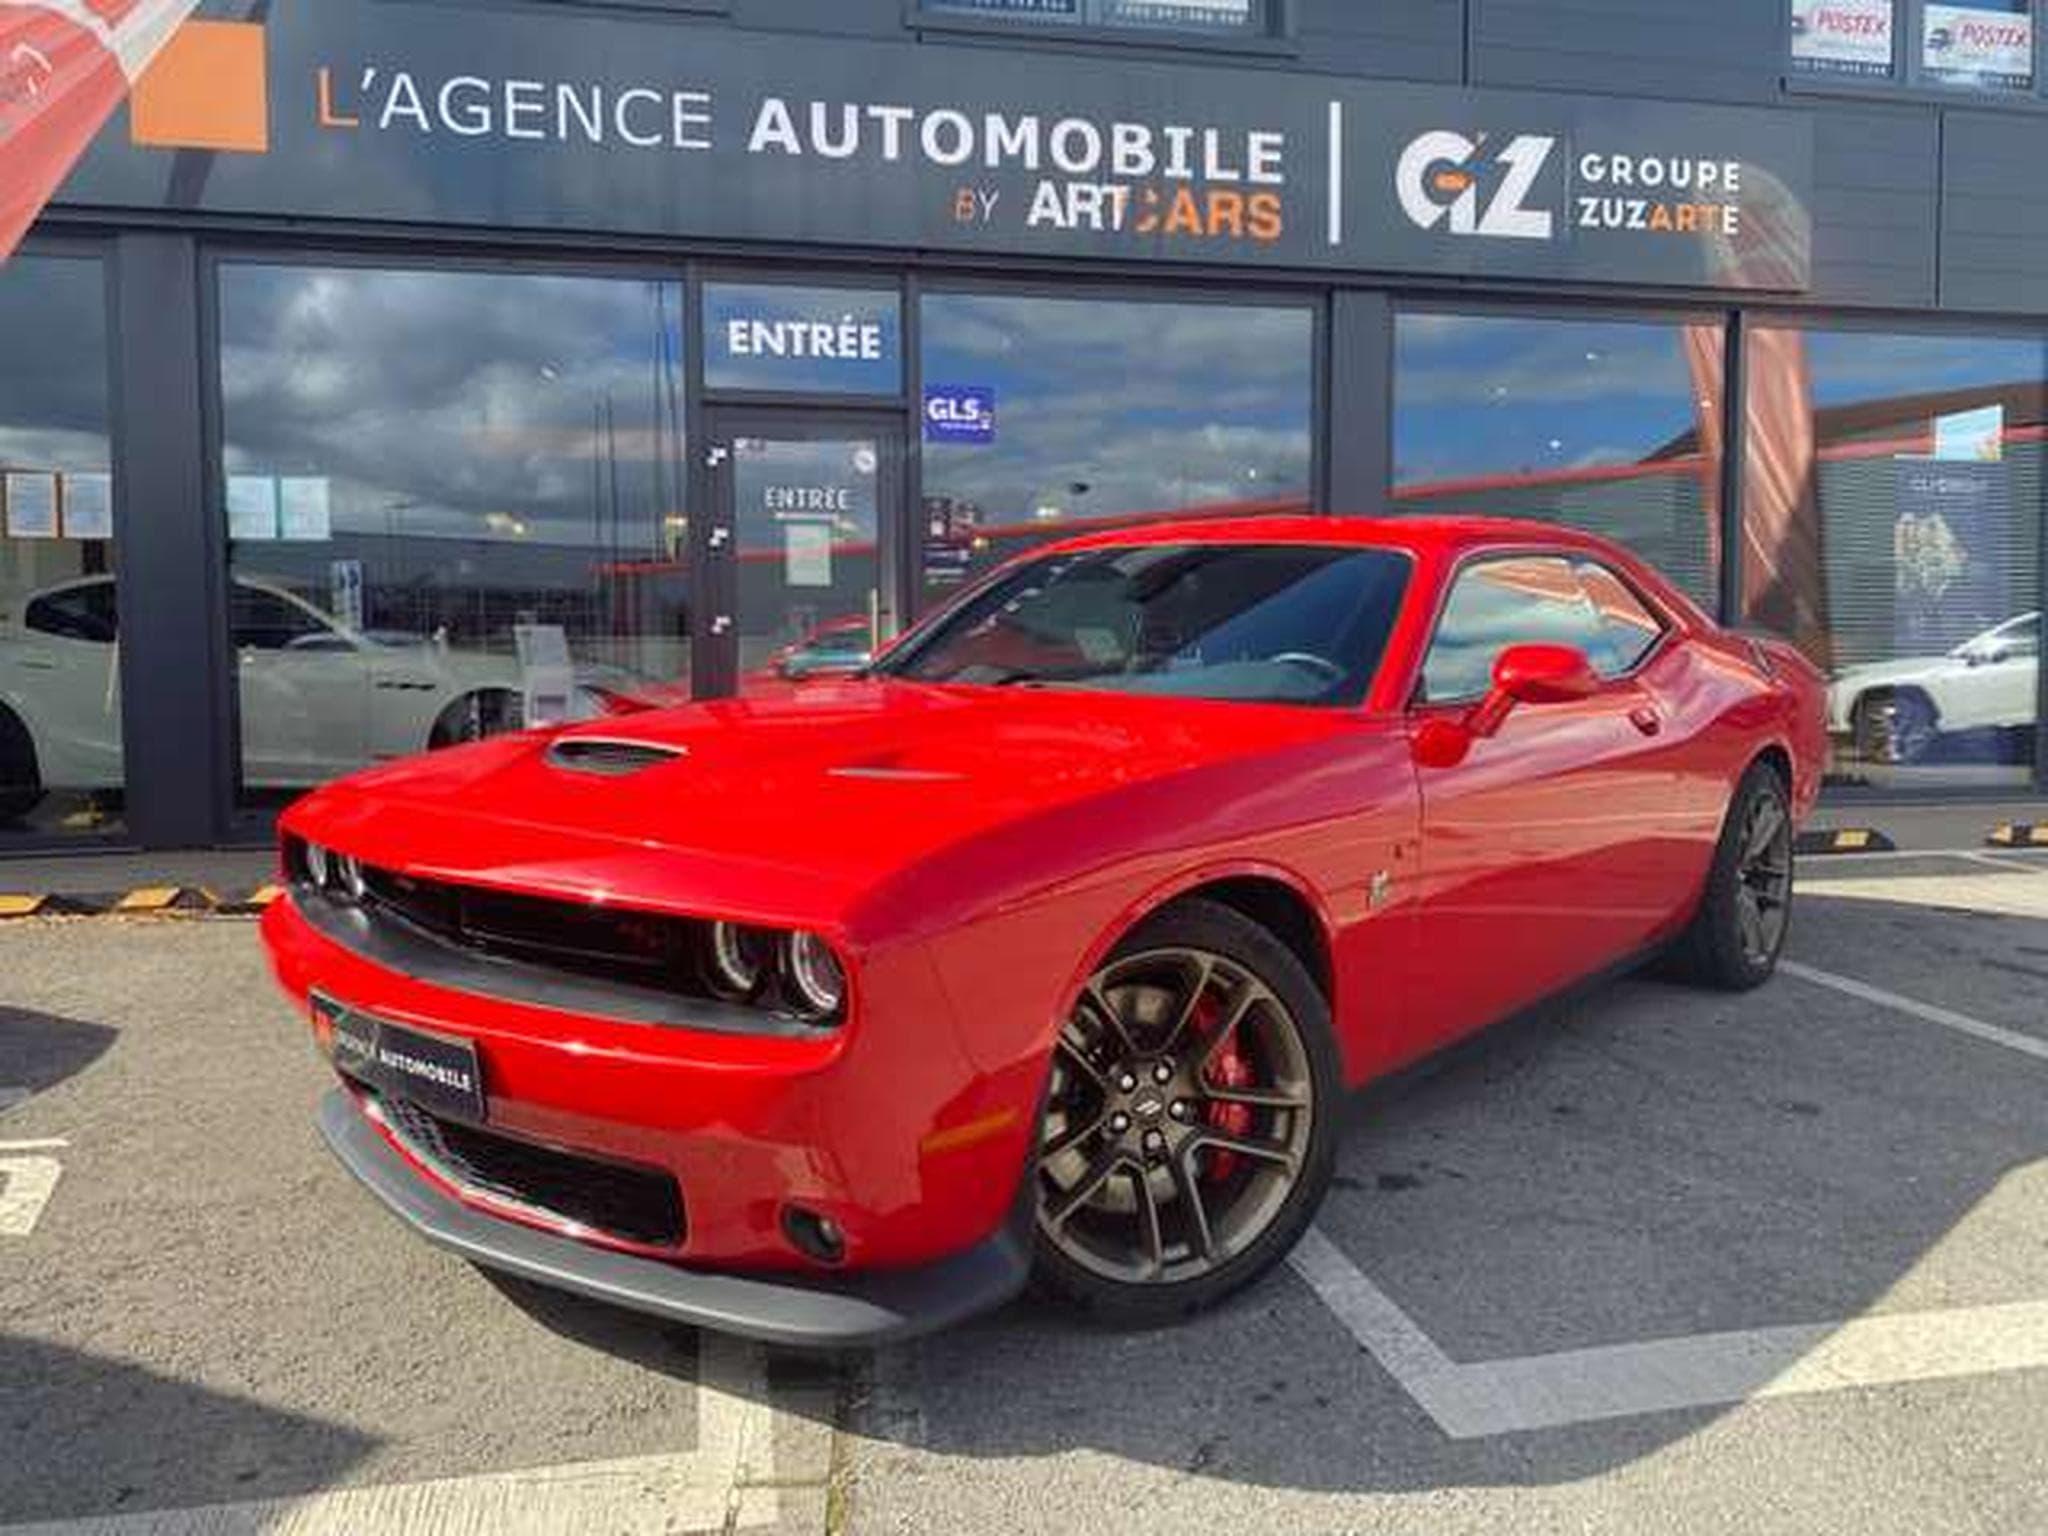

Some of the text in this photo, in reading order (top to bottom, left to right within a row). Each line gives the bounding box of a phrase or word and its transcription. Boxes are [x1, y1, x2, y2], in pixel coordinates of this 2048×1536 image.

[747, 98, 1285, 184] AUTOMOBILE
[1578, 153, 1742, 192] GROUPE
[955, 187, 1000, 222] BY
[1578, 197, 1740, 236] ZUZARTE
[726, 314, 882, 361] ENTRÉE
[928, 397, 980, 421] GLS
[380, 1049, 472, 1092] AUTOMOBILE
